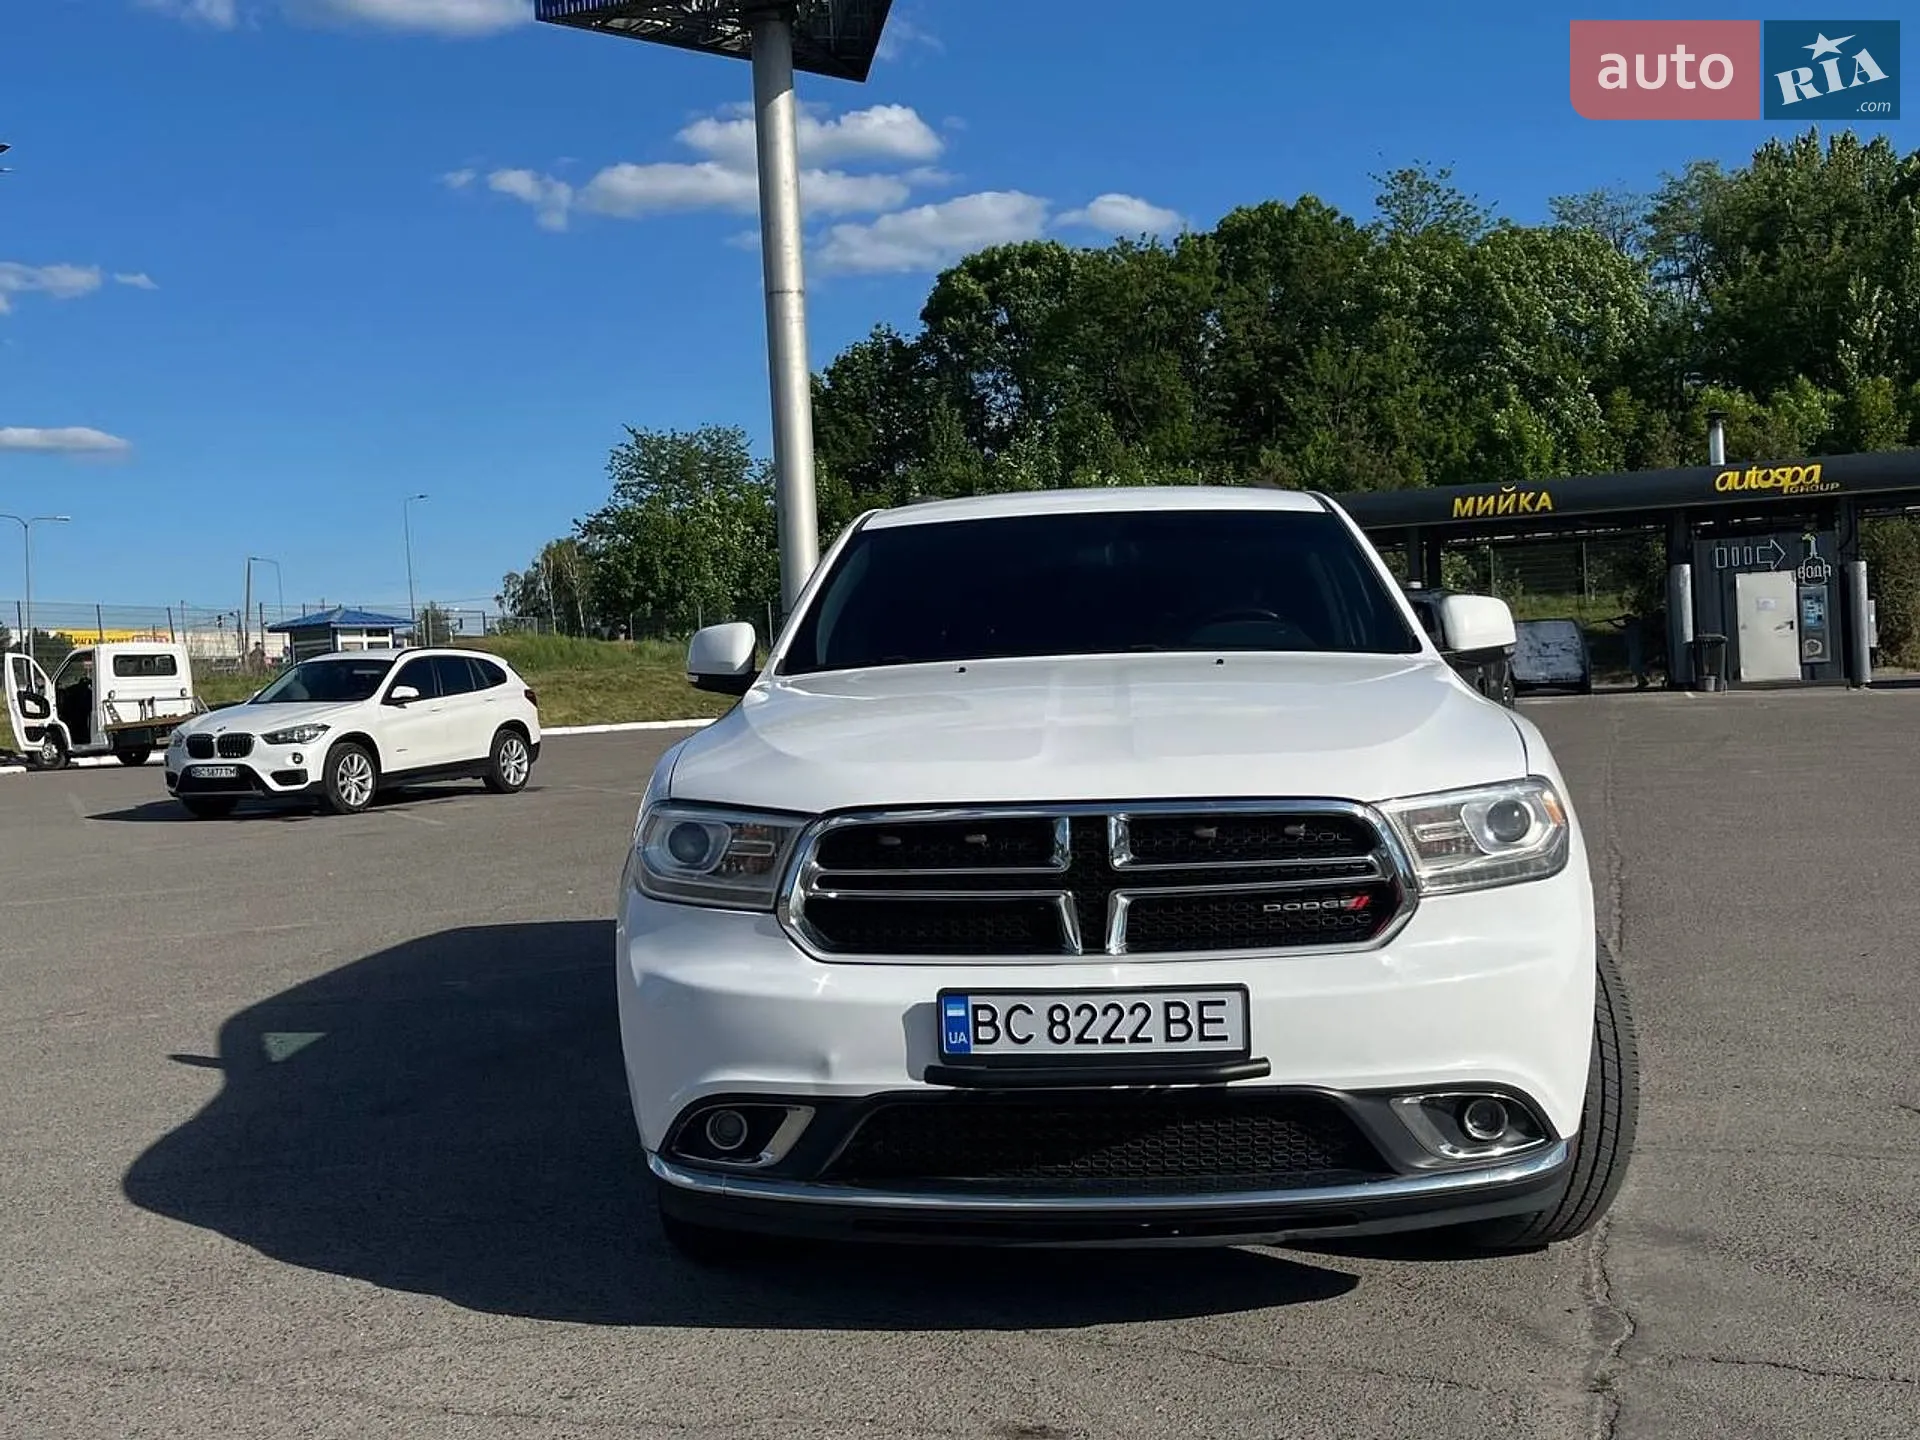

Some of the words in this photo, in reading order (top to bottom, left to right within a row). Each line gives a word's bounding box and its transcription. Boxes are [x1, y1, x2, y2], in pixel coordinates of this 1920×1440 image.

[1713, 464, 1822, 494] autospa
[1789, 482, 1840, 494] GROUP
[1453, 485, 1552, 518] МИЙКА
[1263, 900, 1353, 912] DODGE
[971, 1003, 1035, 1045] BC
[1048, 1002, 1153, 1045] 8222
[1164, 1000, 1228, 1042] BE
[948, 1031, 969, 1044] UA
